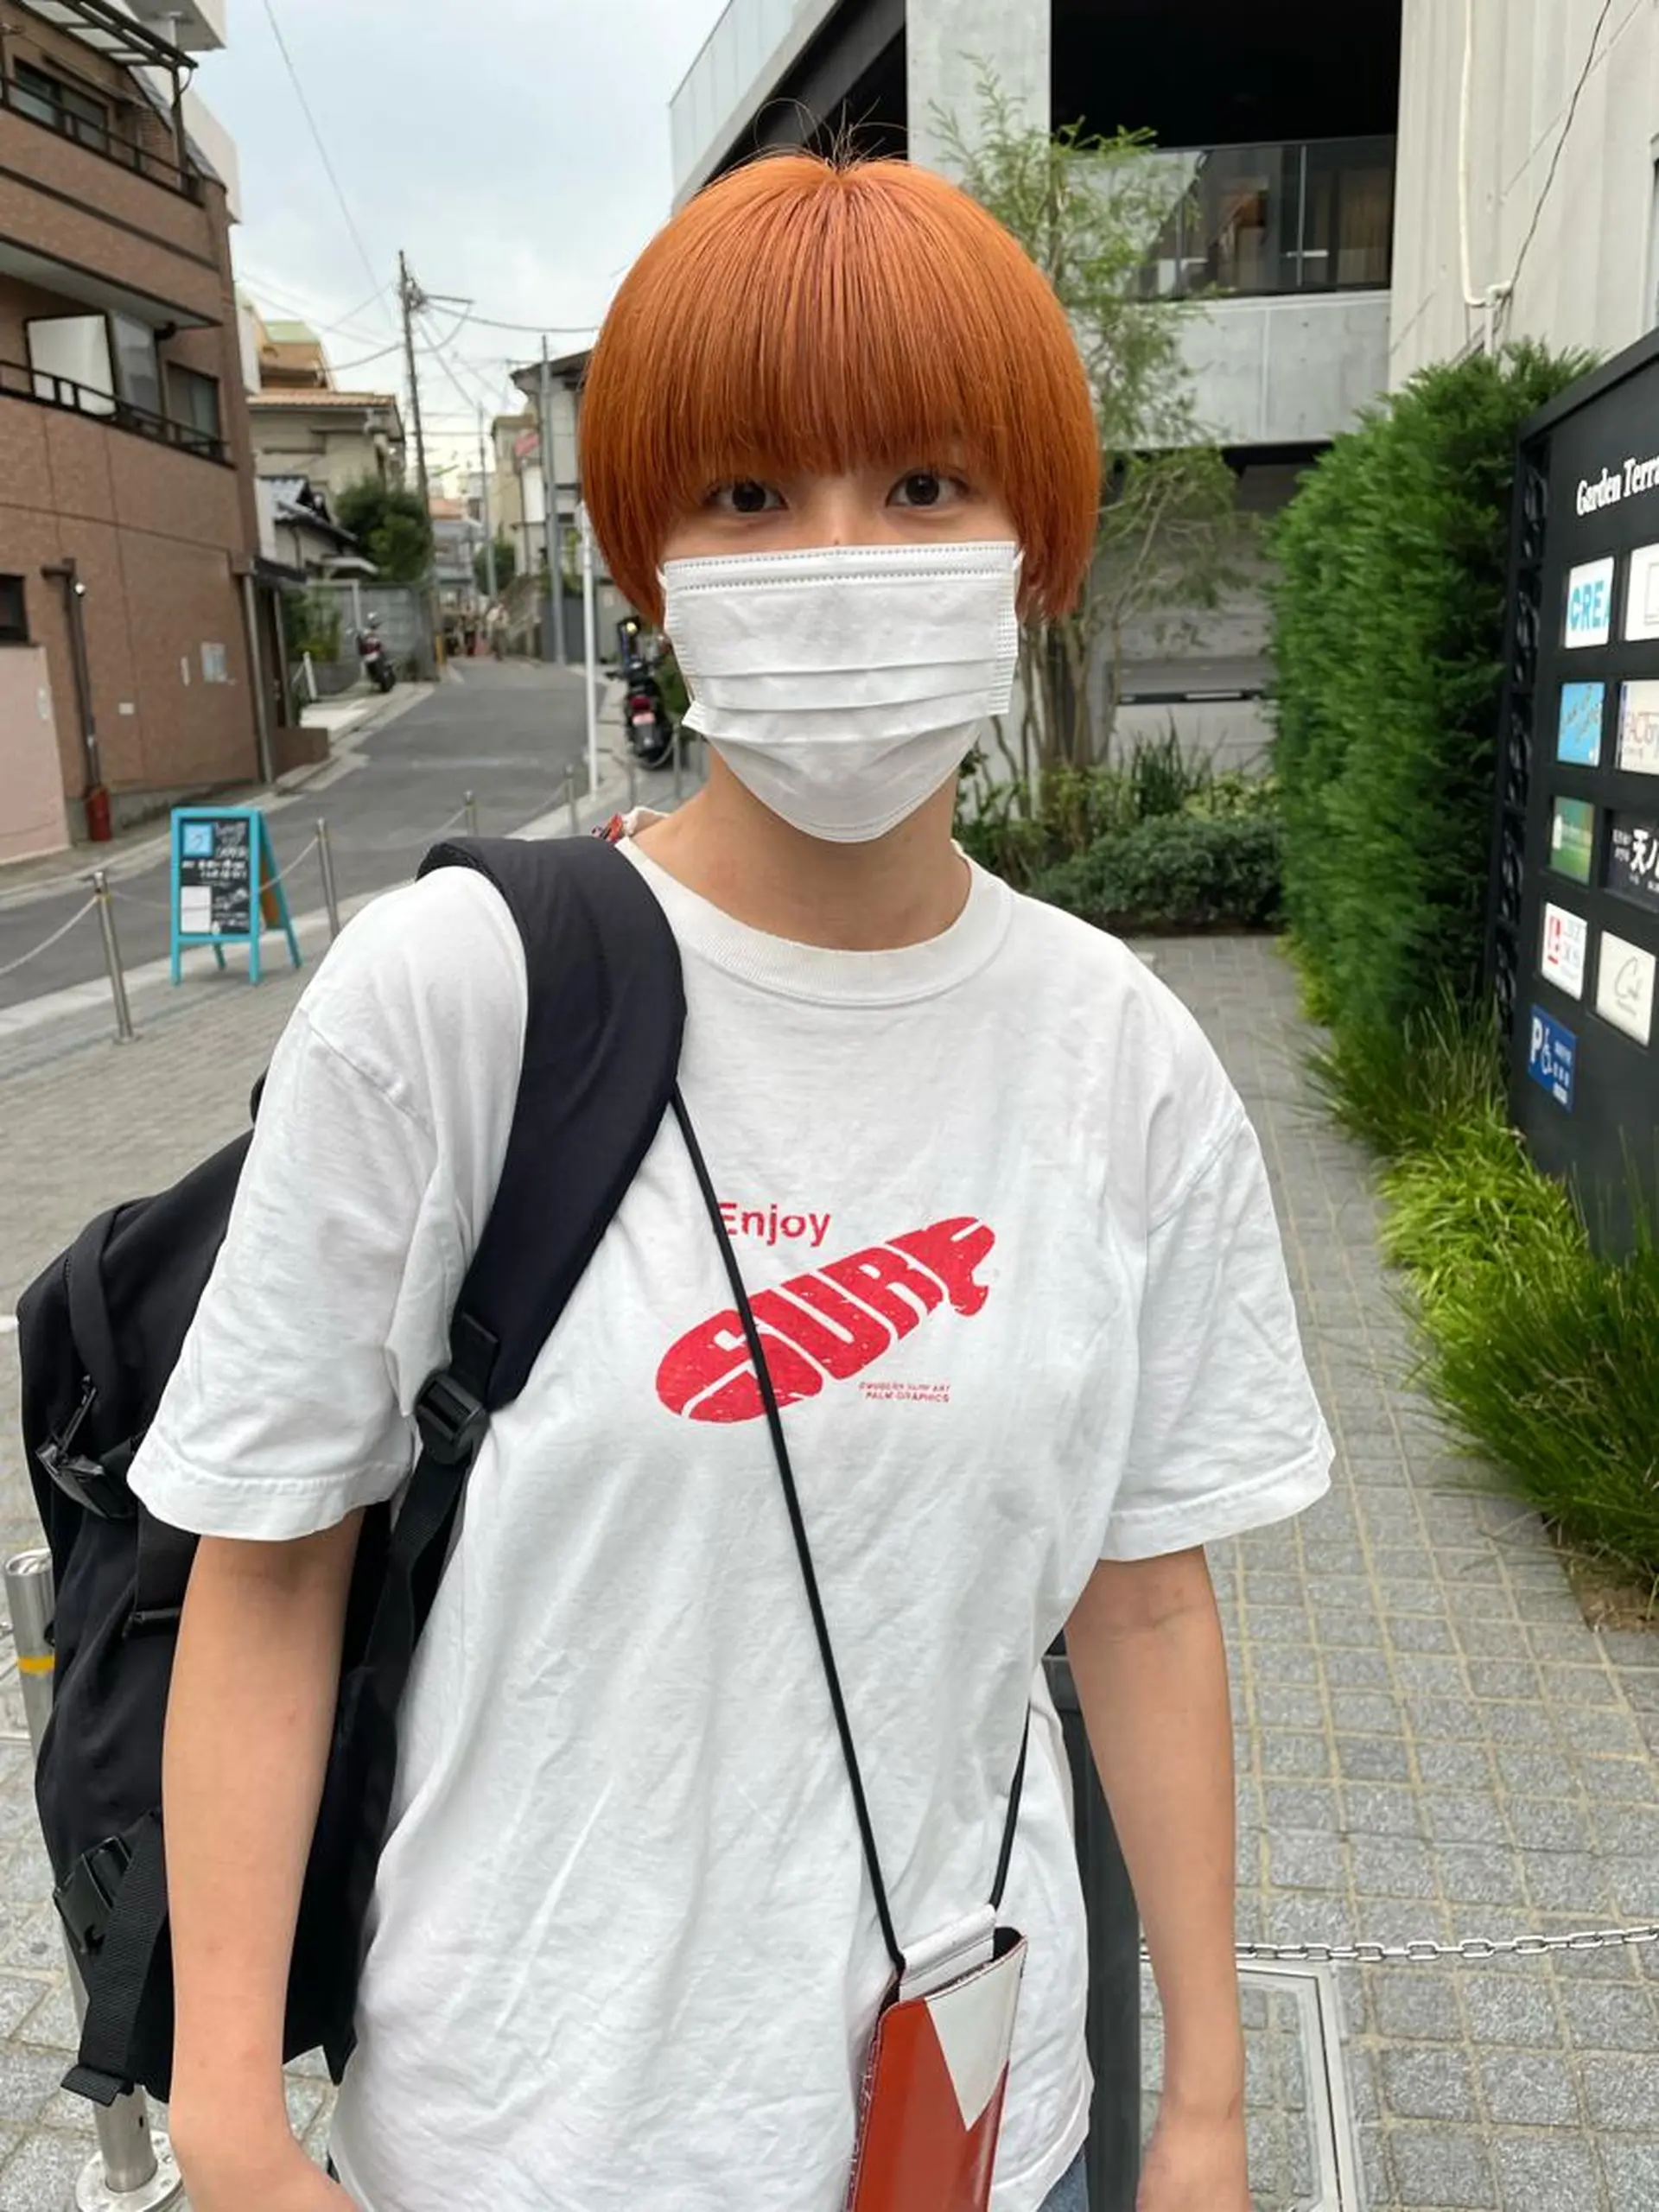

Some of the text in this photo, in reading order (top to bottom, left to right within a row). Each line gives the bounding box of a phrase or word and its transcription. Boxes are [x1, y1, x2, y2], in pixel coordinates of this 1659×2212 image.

[1576, 467, 1622, 517] Garden
[718, 1202, 831, 1247] Enjoy
[655, 1215, 996, 1424] SURF
